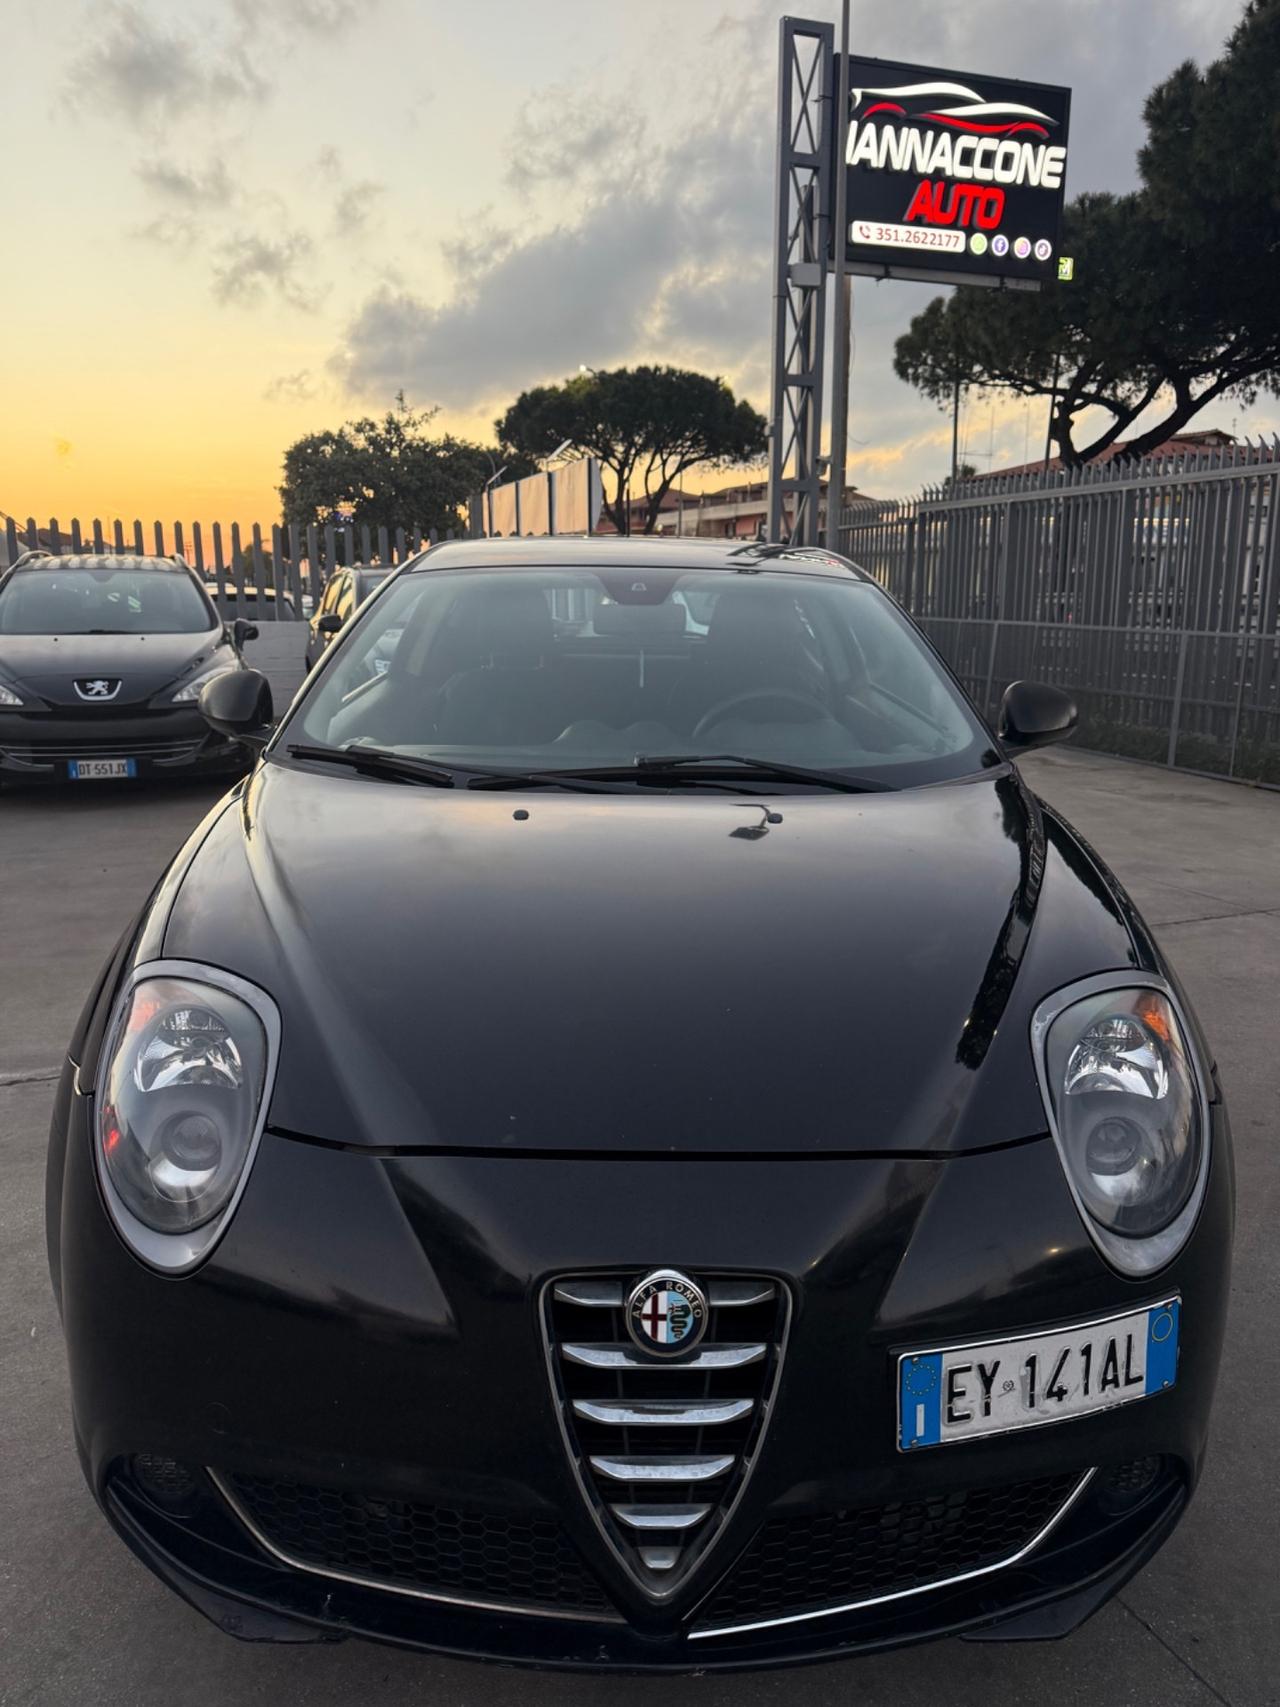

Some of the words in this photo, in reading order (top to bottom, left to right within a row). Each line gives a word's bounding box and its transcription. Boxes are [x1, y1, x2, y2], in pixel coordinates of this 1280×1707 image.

[845, 119, 1067, 189] IANNACCONE
[904, 179, 1005, 230] AUTO
[876, 227, 960, 249] 351.2622177
[79, 763, 91, 775] DT
[632, 1285, 657, 1318] ALFA
[665, 1281, 702, 1318] ROMEO
[947, 1359, 1001, 1423] EY
[1024, 1333, 1144, 1409] 141AL
